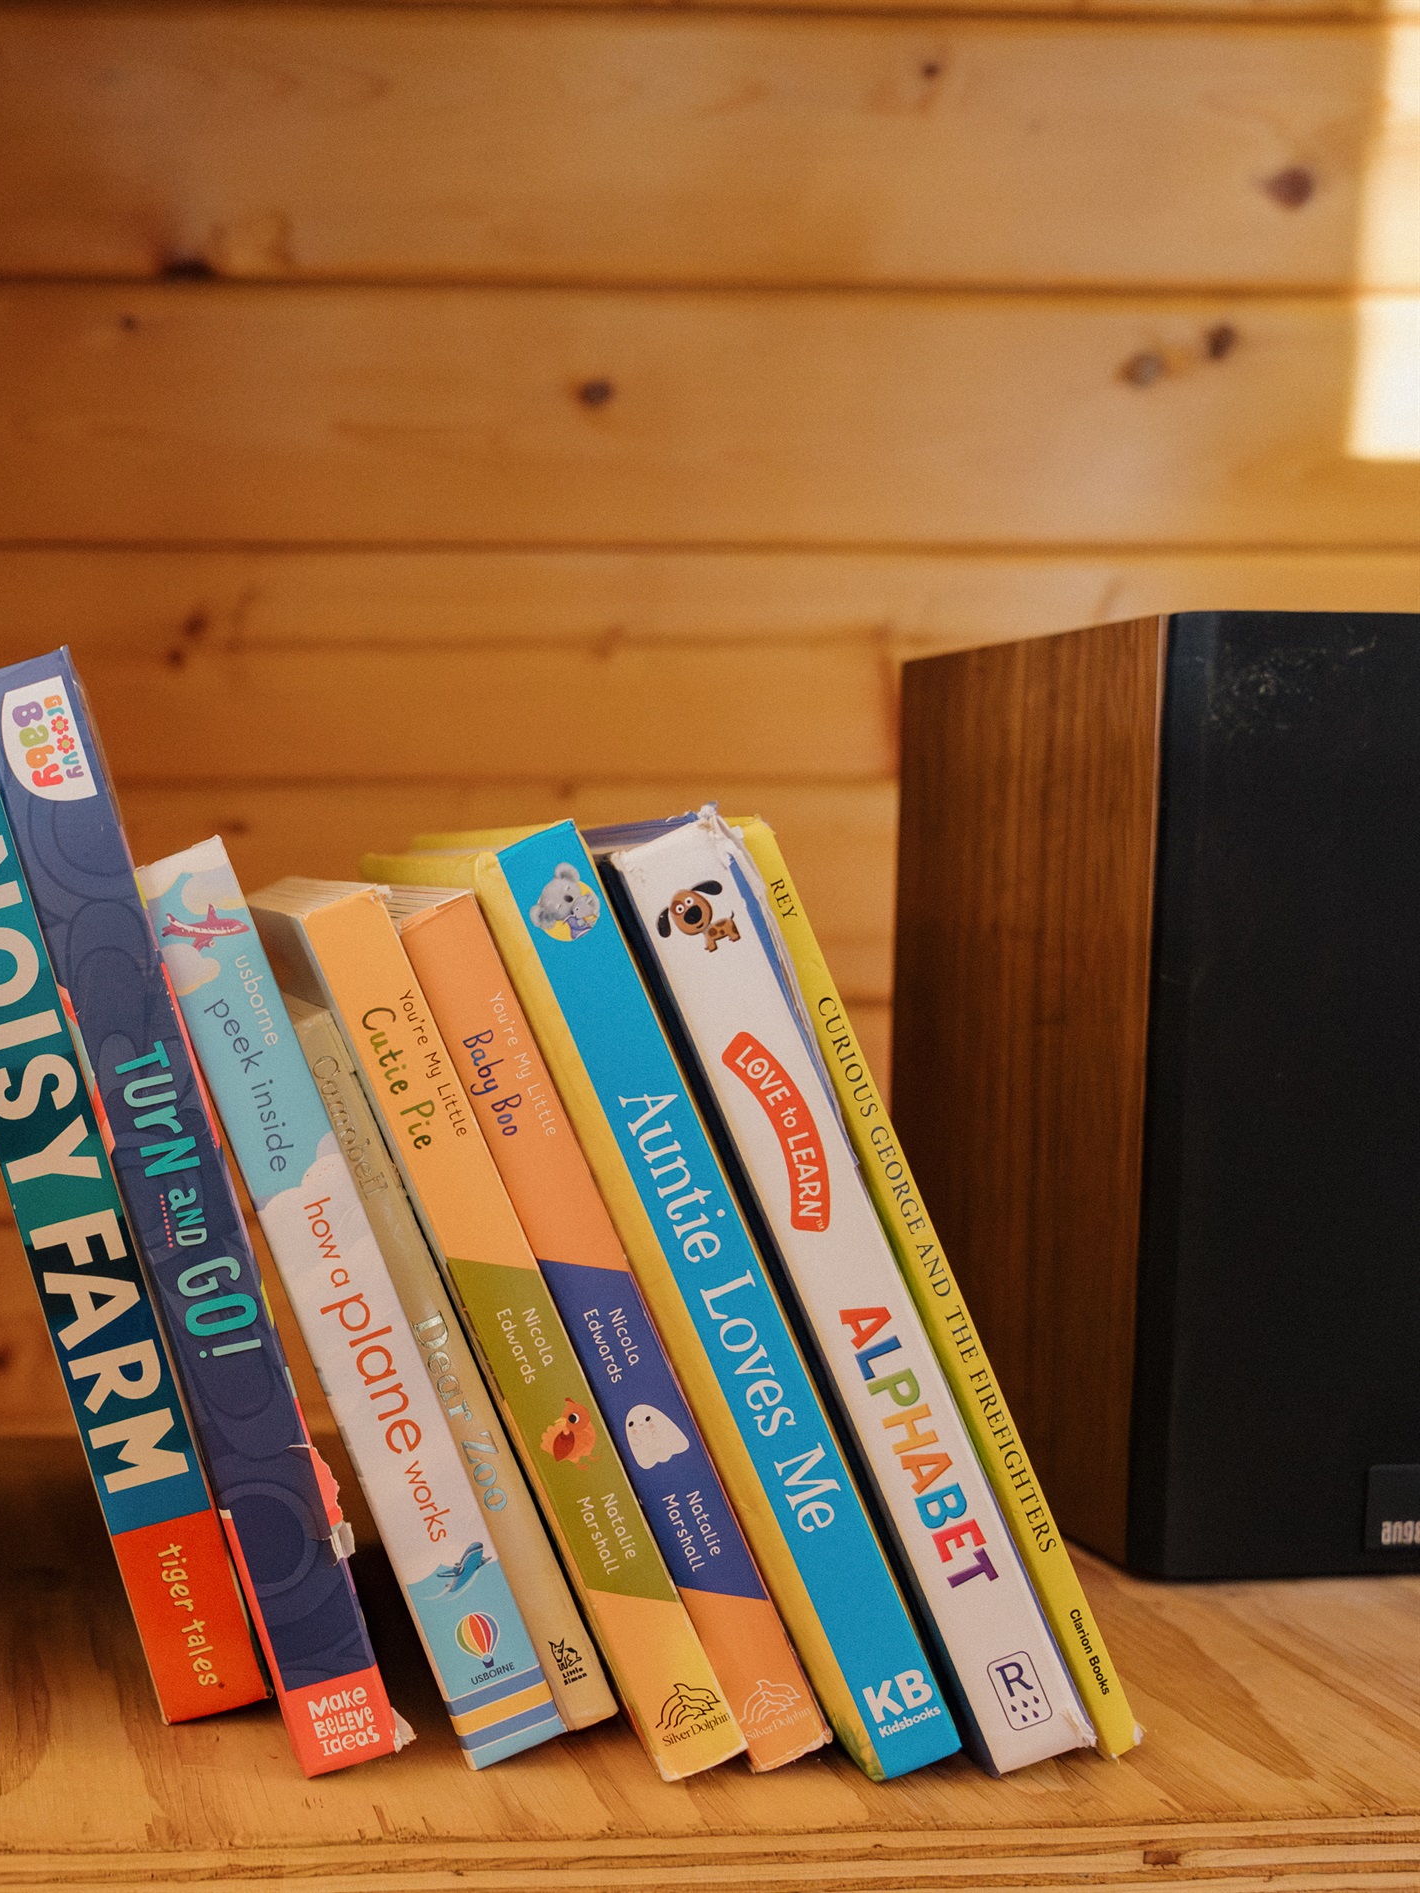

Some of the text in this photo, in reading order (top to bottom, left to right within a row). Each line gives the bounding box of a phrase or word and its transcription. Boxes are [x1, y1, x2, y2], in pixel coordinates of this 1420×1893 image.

[12, 701, 64, 787] Baby
[770, 878, 798, 919] REY
[235, 955, 278, 1046] usborne
[204, 998, 294, 1172] peek inside
[362, 1007, 435, 1150] Cutie Pie
[399, 989, 467, 1138] You're My Little
[462, 1029, 522, 1136] Baby Boo
[490, 991, 557, 1137] You're My Little
[735, 1045, 791, 1107] LOVE
[780, 1107, 797, 1128] to
[177, 1256, 262, 1358] GO!
[618, 1094, 841, 1533] Auntie Loves Me
[818, 997, 1057, 1554] CURIOUS GEORGE AND THE FIREFIGHTERS
[29, 1208, 189, 1494] FARM
[304, 1197, 451, 1543] how a plane works
[496, 1308, 536, 1385] Edwards
[522, 1307, 554, 1367] Nicola
[583, 1308, 623, 1384] Edwards
[608, 1307, 640, 1366] Nicola
[411, 1310, 507, 1511] Dear Zoo
[838, 1306, 999, 1589] ALPHABET
[577, 1496, 620, 1575] Marshall
[601, 1493, 636, 1559] Natalie
[662, 1493, 705, 1572] Marshall
[686, 1490, 721, 1556] Natalie
[157, 1543, 218, 1686] tiger tales
[1069, 1608, 1110, 1695] Clarion Books
[307, 1686, 367, 1720] Make
[470, 1662, 515, 1685] USBORNE
[562, 1666, 583, 1679] Little
[563, 1672, 587, 1686] Simon
[862, 1669, 933, 1724] KB
[995, 1662, 1034, 1697] R
[319, 1725, 380, 1756] Ideas
[878, 1706, 941, 1738] Kidsbooks
